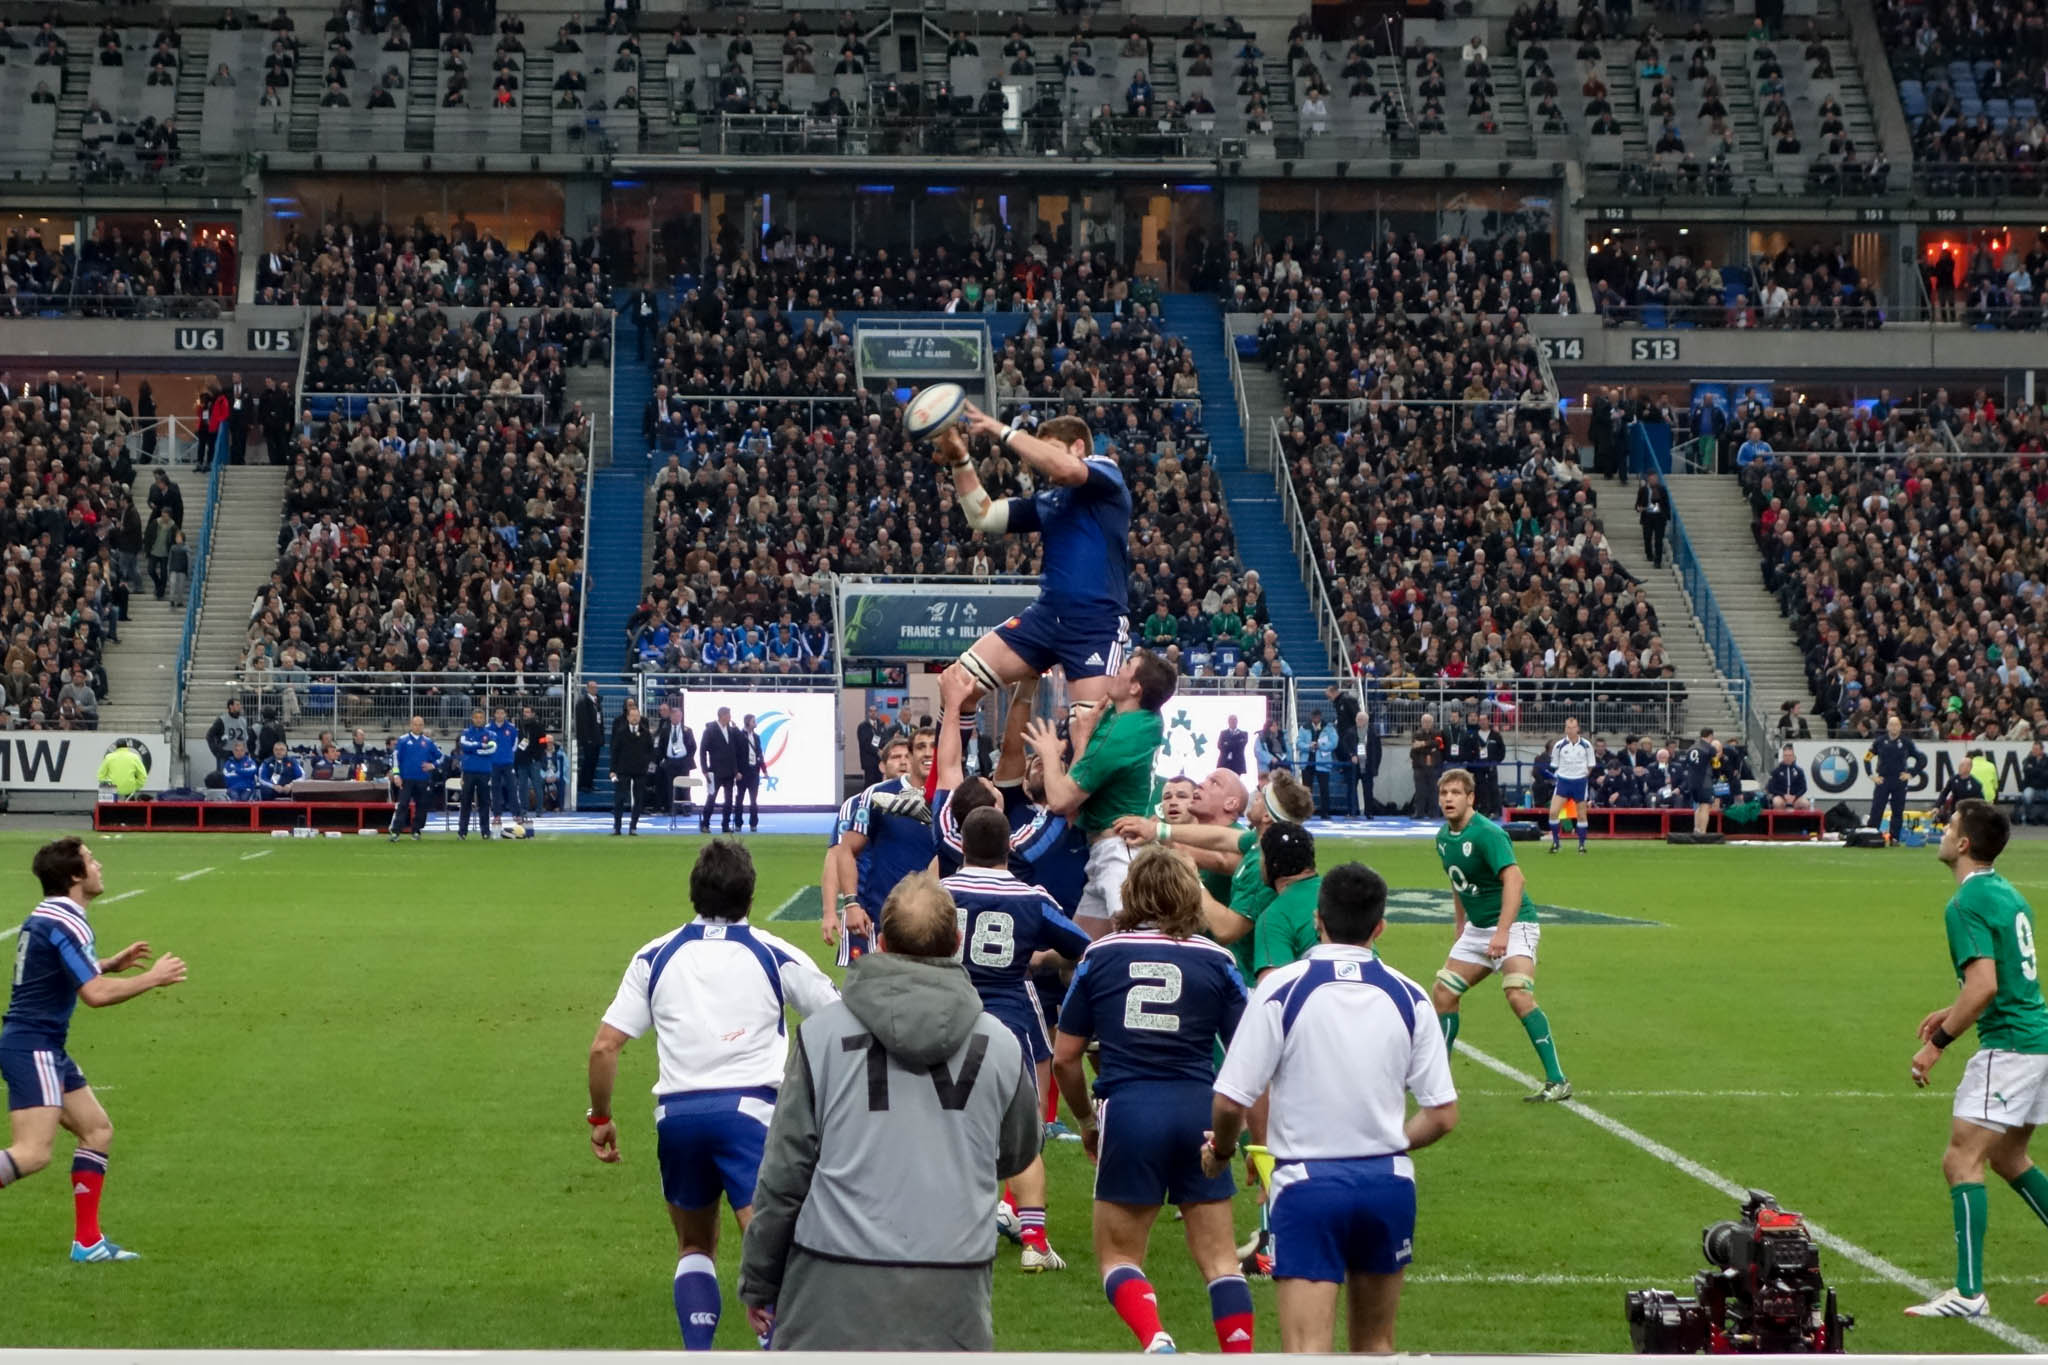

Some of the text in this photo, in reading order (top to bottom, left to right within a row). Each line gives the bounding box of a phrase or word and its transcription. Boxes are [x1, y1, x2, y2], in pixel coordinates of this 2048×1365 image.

[1605, 208, 1624, 219] 152
[1936, 209, 1956, 220] 150
[181, 330, 218, 349] U6
[254, 331, 290, 350] U5
[888, 350, 912, 358] FRANCE
[1540, 340, 1581, 359] S14
[1635, 340, 1676, 359] S13
[901, 625, 941, 638] FRANCE
[229, 728, 244, 741] 92
[0, 739, 70, 782] W
[1448, 865, 1479, 896] O2
[2016, 912, 2037, 981] 9
[1124, 962, 1182, 1031] 2
[841, 1032, 990, 1112] TV
